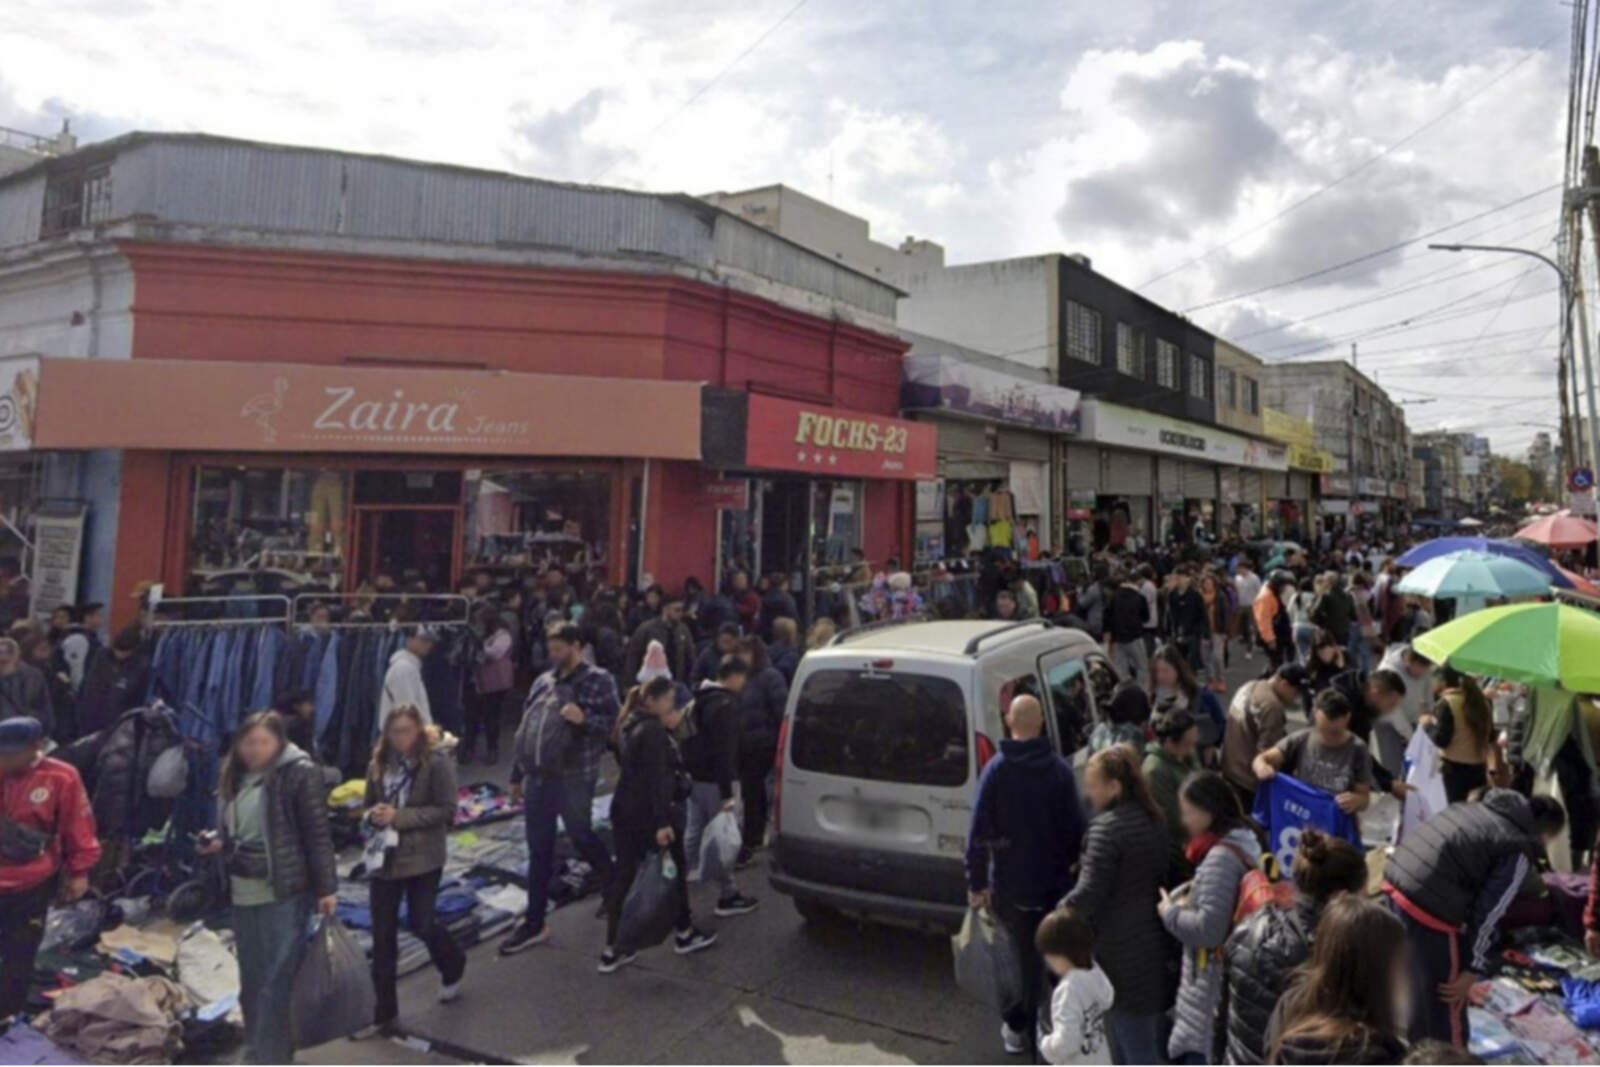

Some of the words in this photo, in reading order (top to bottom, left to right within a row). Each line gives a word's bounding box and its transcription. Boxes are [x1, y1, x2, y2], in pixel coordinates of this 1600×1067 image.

[314, 386, 459, 432] Zaira
[467, 416, 529, 435] Jeans
[795, 411, 908, 453] FOCHS-23
[1283, 800, 1311, 820] ENZO
[1276, 826, 1302, 878] 8
